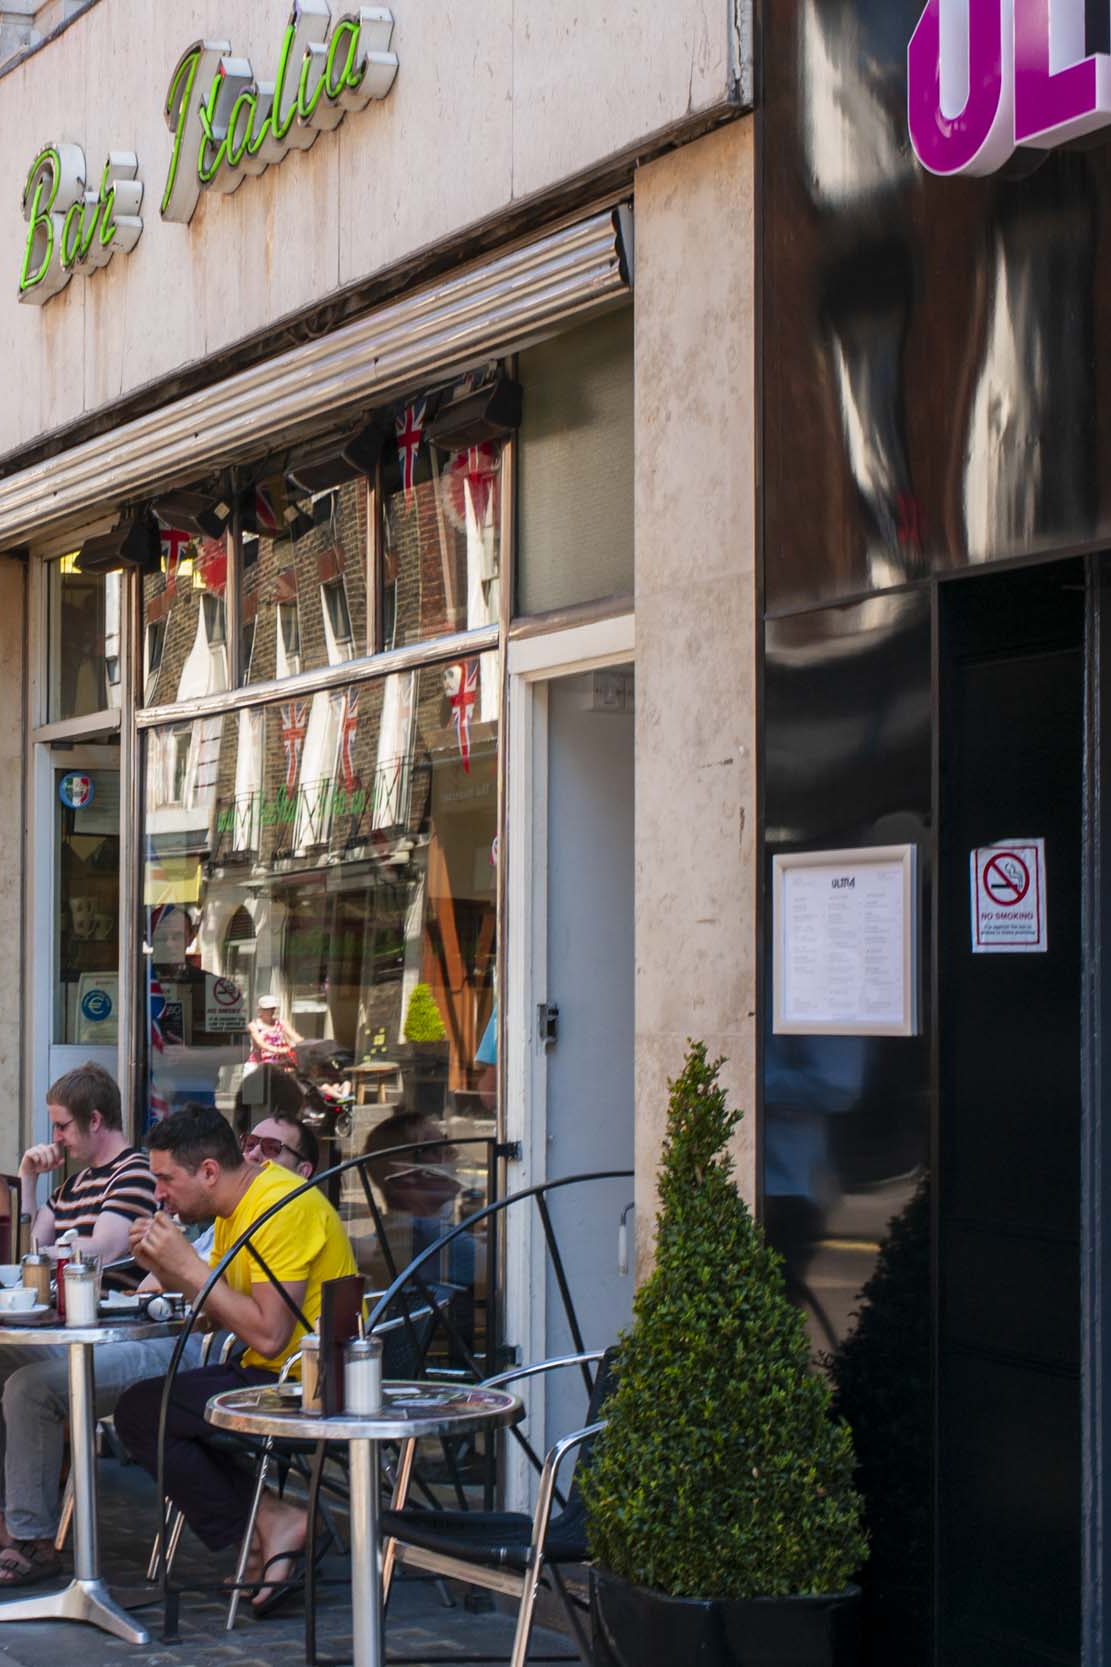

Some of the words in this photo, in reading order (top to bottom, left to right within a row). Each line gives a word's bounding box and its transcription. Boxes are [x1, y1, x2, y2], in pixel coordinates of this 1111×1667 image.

[18, 143, 133, 300] Bar
[160, 0, 388, 221] Italia
[981, 911, 993, 920] NO
[995, 911, 1034, 920] SMOKING
